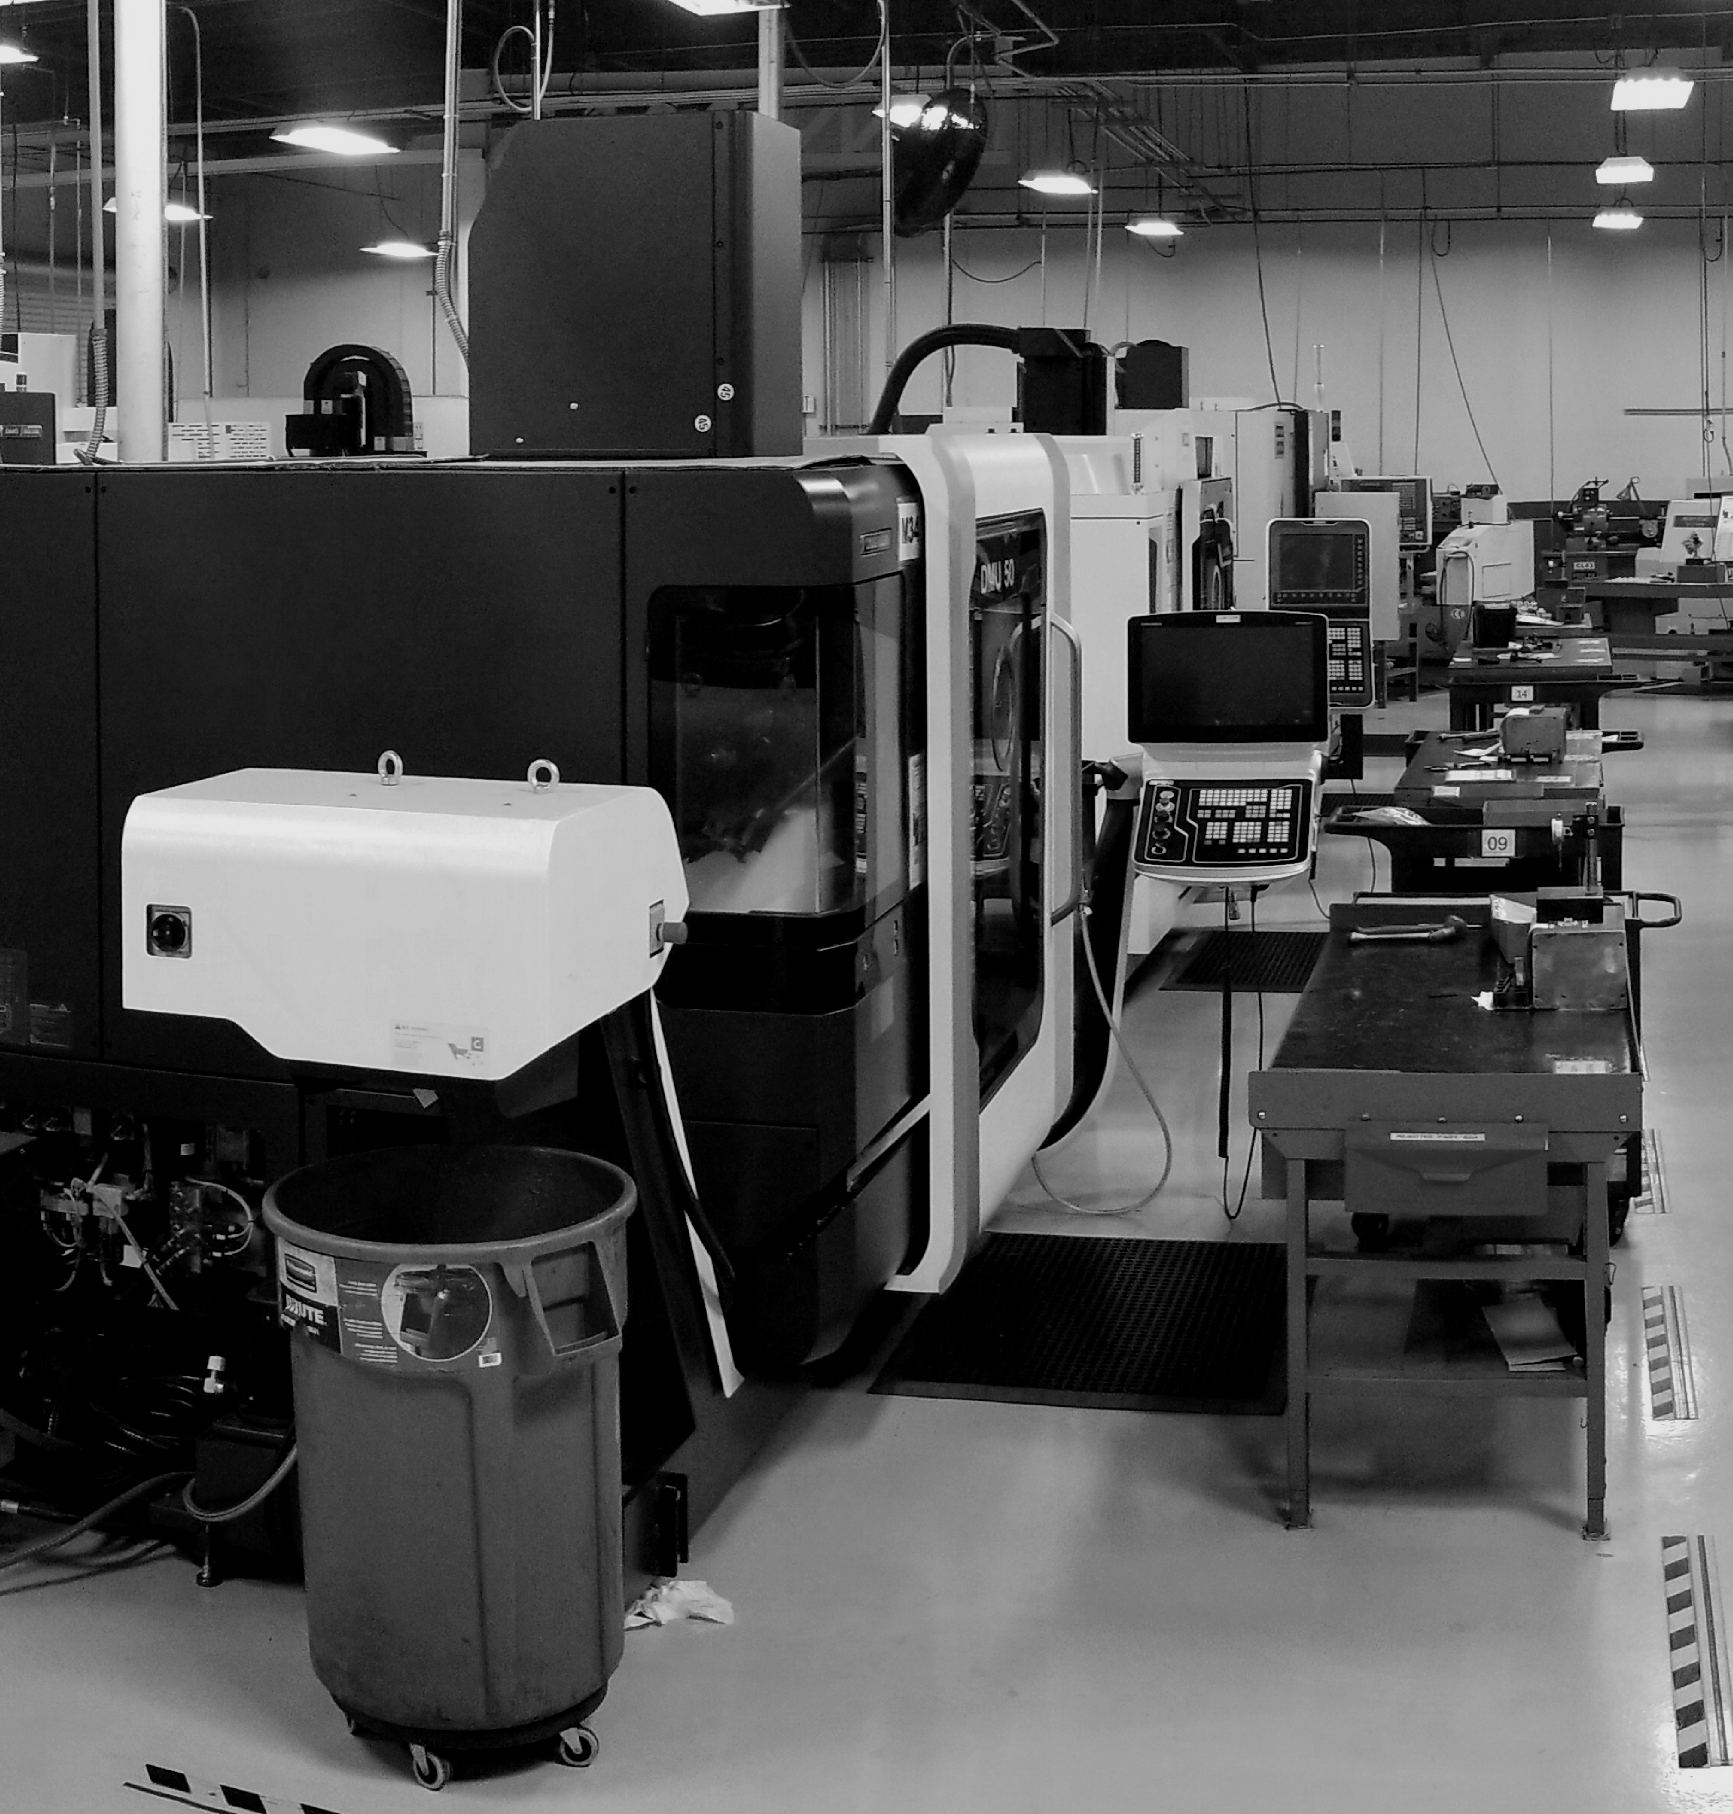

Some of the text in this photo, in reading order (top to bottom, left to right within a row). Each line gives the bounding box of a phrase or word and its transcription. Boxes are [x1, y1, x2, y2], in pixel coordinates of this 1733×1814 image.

[980, 558, 1016, 595] DMU 50
[1487, 836, 1508, 851] 09
